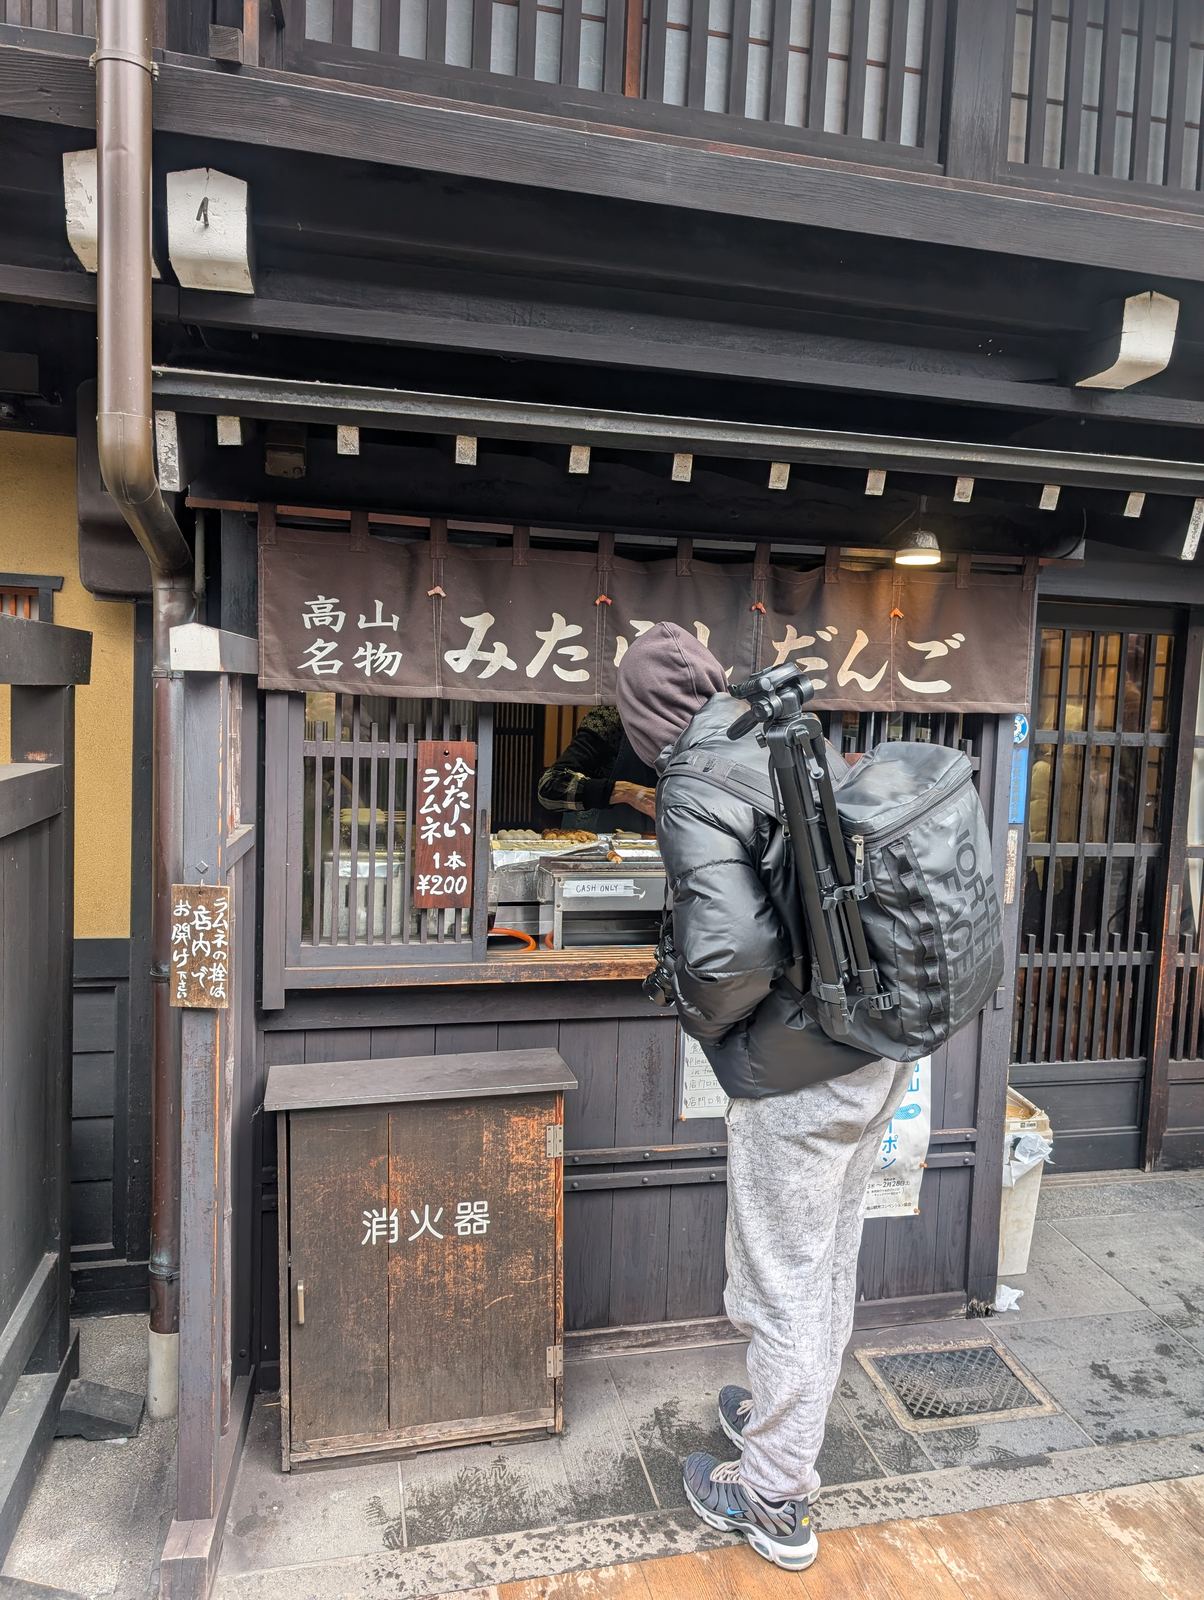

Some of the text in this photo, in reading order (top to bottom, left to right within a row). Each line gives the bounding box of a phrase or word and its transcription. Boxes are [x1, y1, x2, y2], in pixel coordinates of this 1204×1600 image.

[302, 595, 400, 632] 高山
[298, 638, 403, 677] 名物
[419, 768, 442, 845] ラムネ
[432, 851, 466, 870] 1本
[416, 874, 468, 896] ¥200
[576, 884, 619, 893] CASH ONLY
[171, 899, 192, 999] お開け下さい
[190, 905, 212, 989] 店内で
[208, 897, 229, 999] ラムネの栓は
[361, 1200, 491, 1245] 消火器
